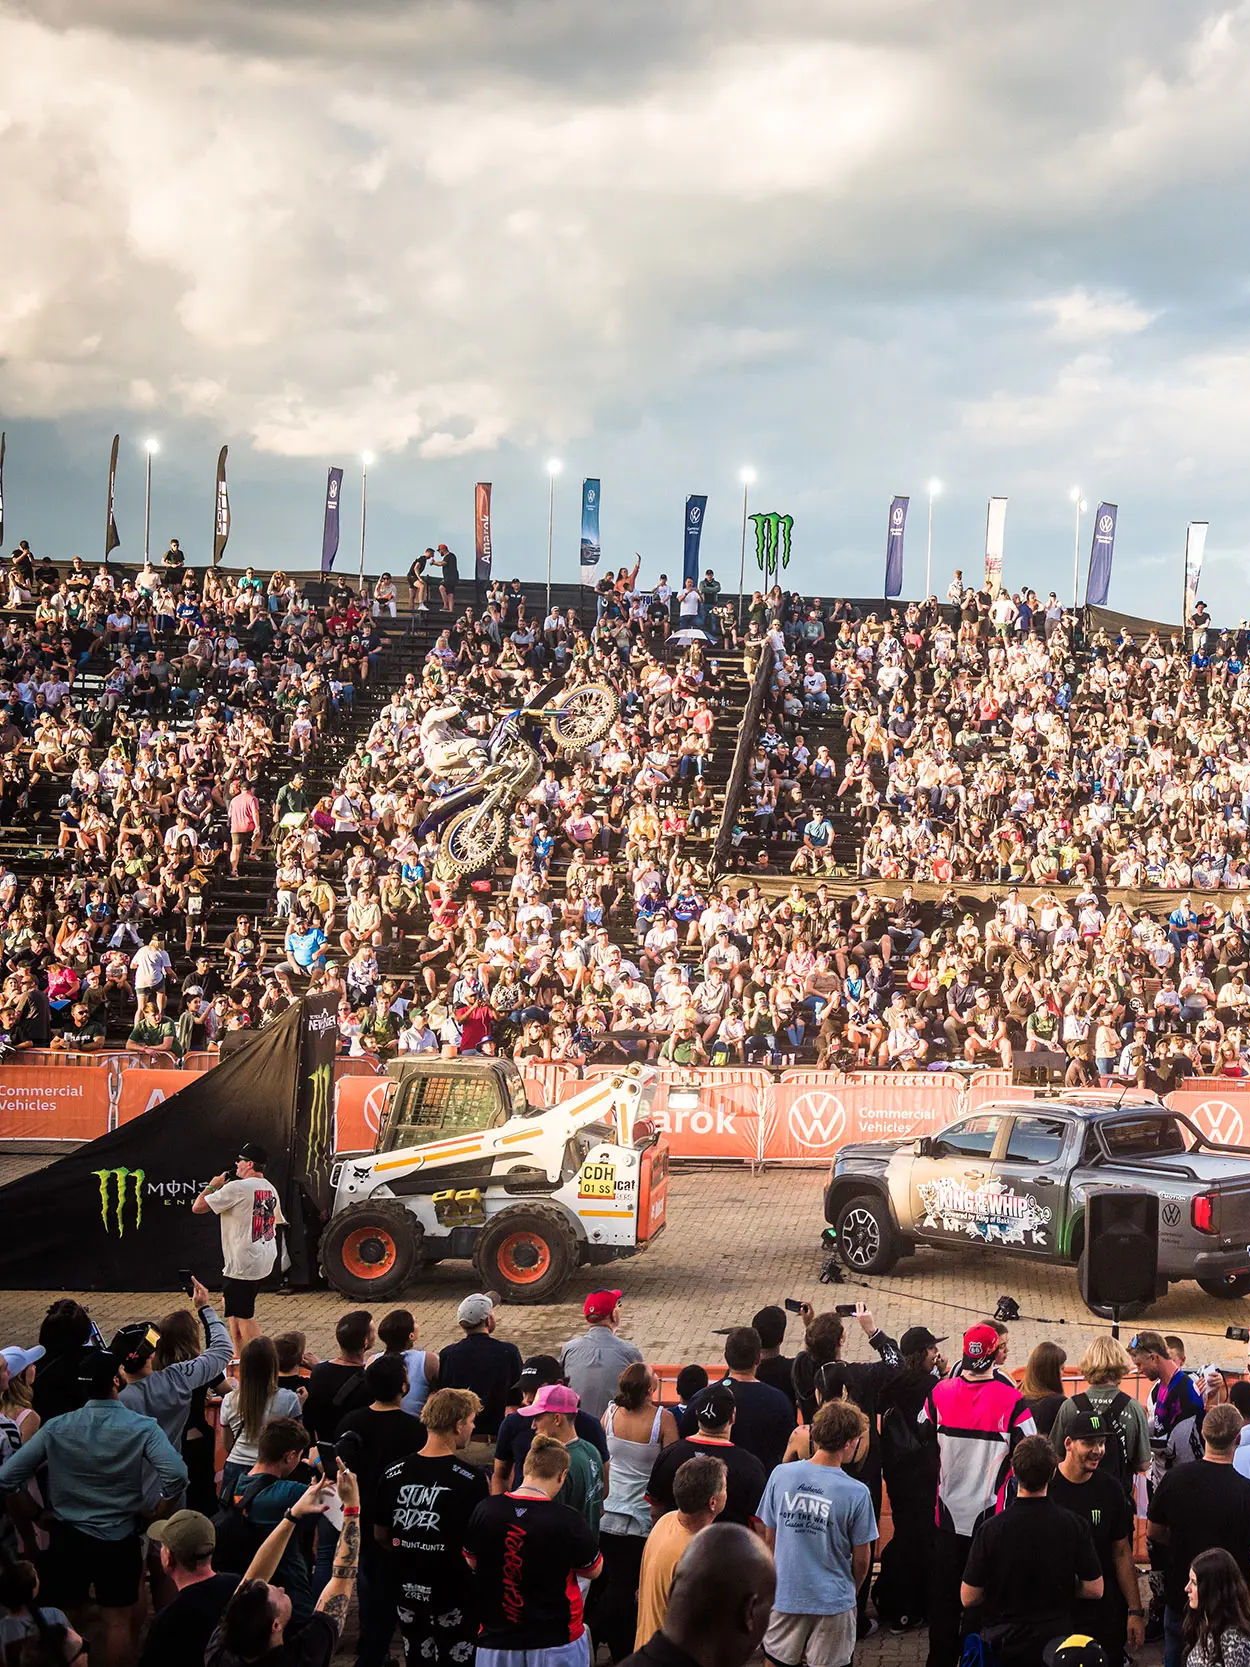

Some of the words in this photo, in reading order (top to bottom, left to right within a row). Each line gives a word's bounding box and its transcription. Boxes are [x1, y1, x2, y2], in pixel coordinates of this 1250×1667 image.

[480, 514, 491, 563] Amarok
[0, 1085, 83, 1097] Commercial
[652, 1102, 737, 1135] arok
[859, 1107, 936, 1120] Commercial
[859, 1121, 912, 1134] Vehicles
[584, 1165, 614, 1181] CDH
[598, 1184, 611, 1194] SS
[938, 1189, 974, 1212] KING
[987, 1193, 1028, 1218] WHIP
[397, 1481, 453, 1512] STUNT
[797, 1483, 824, 1495] Authentic
[784, 1491, 833, 1518] VANS
[392, 1508, 441, 1532] RIDER
[405, 1591, 430, 1602] CREW
